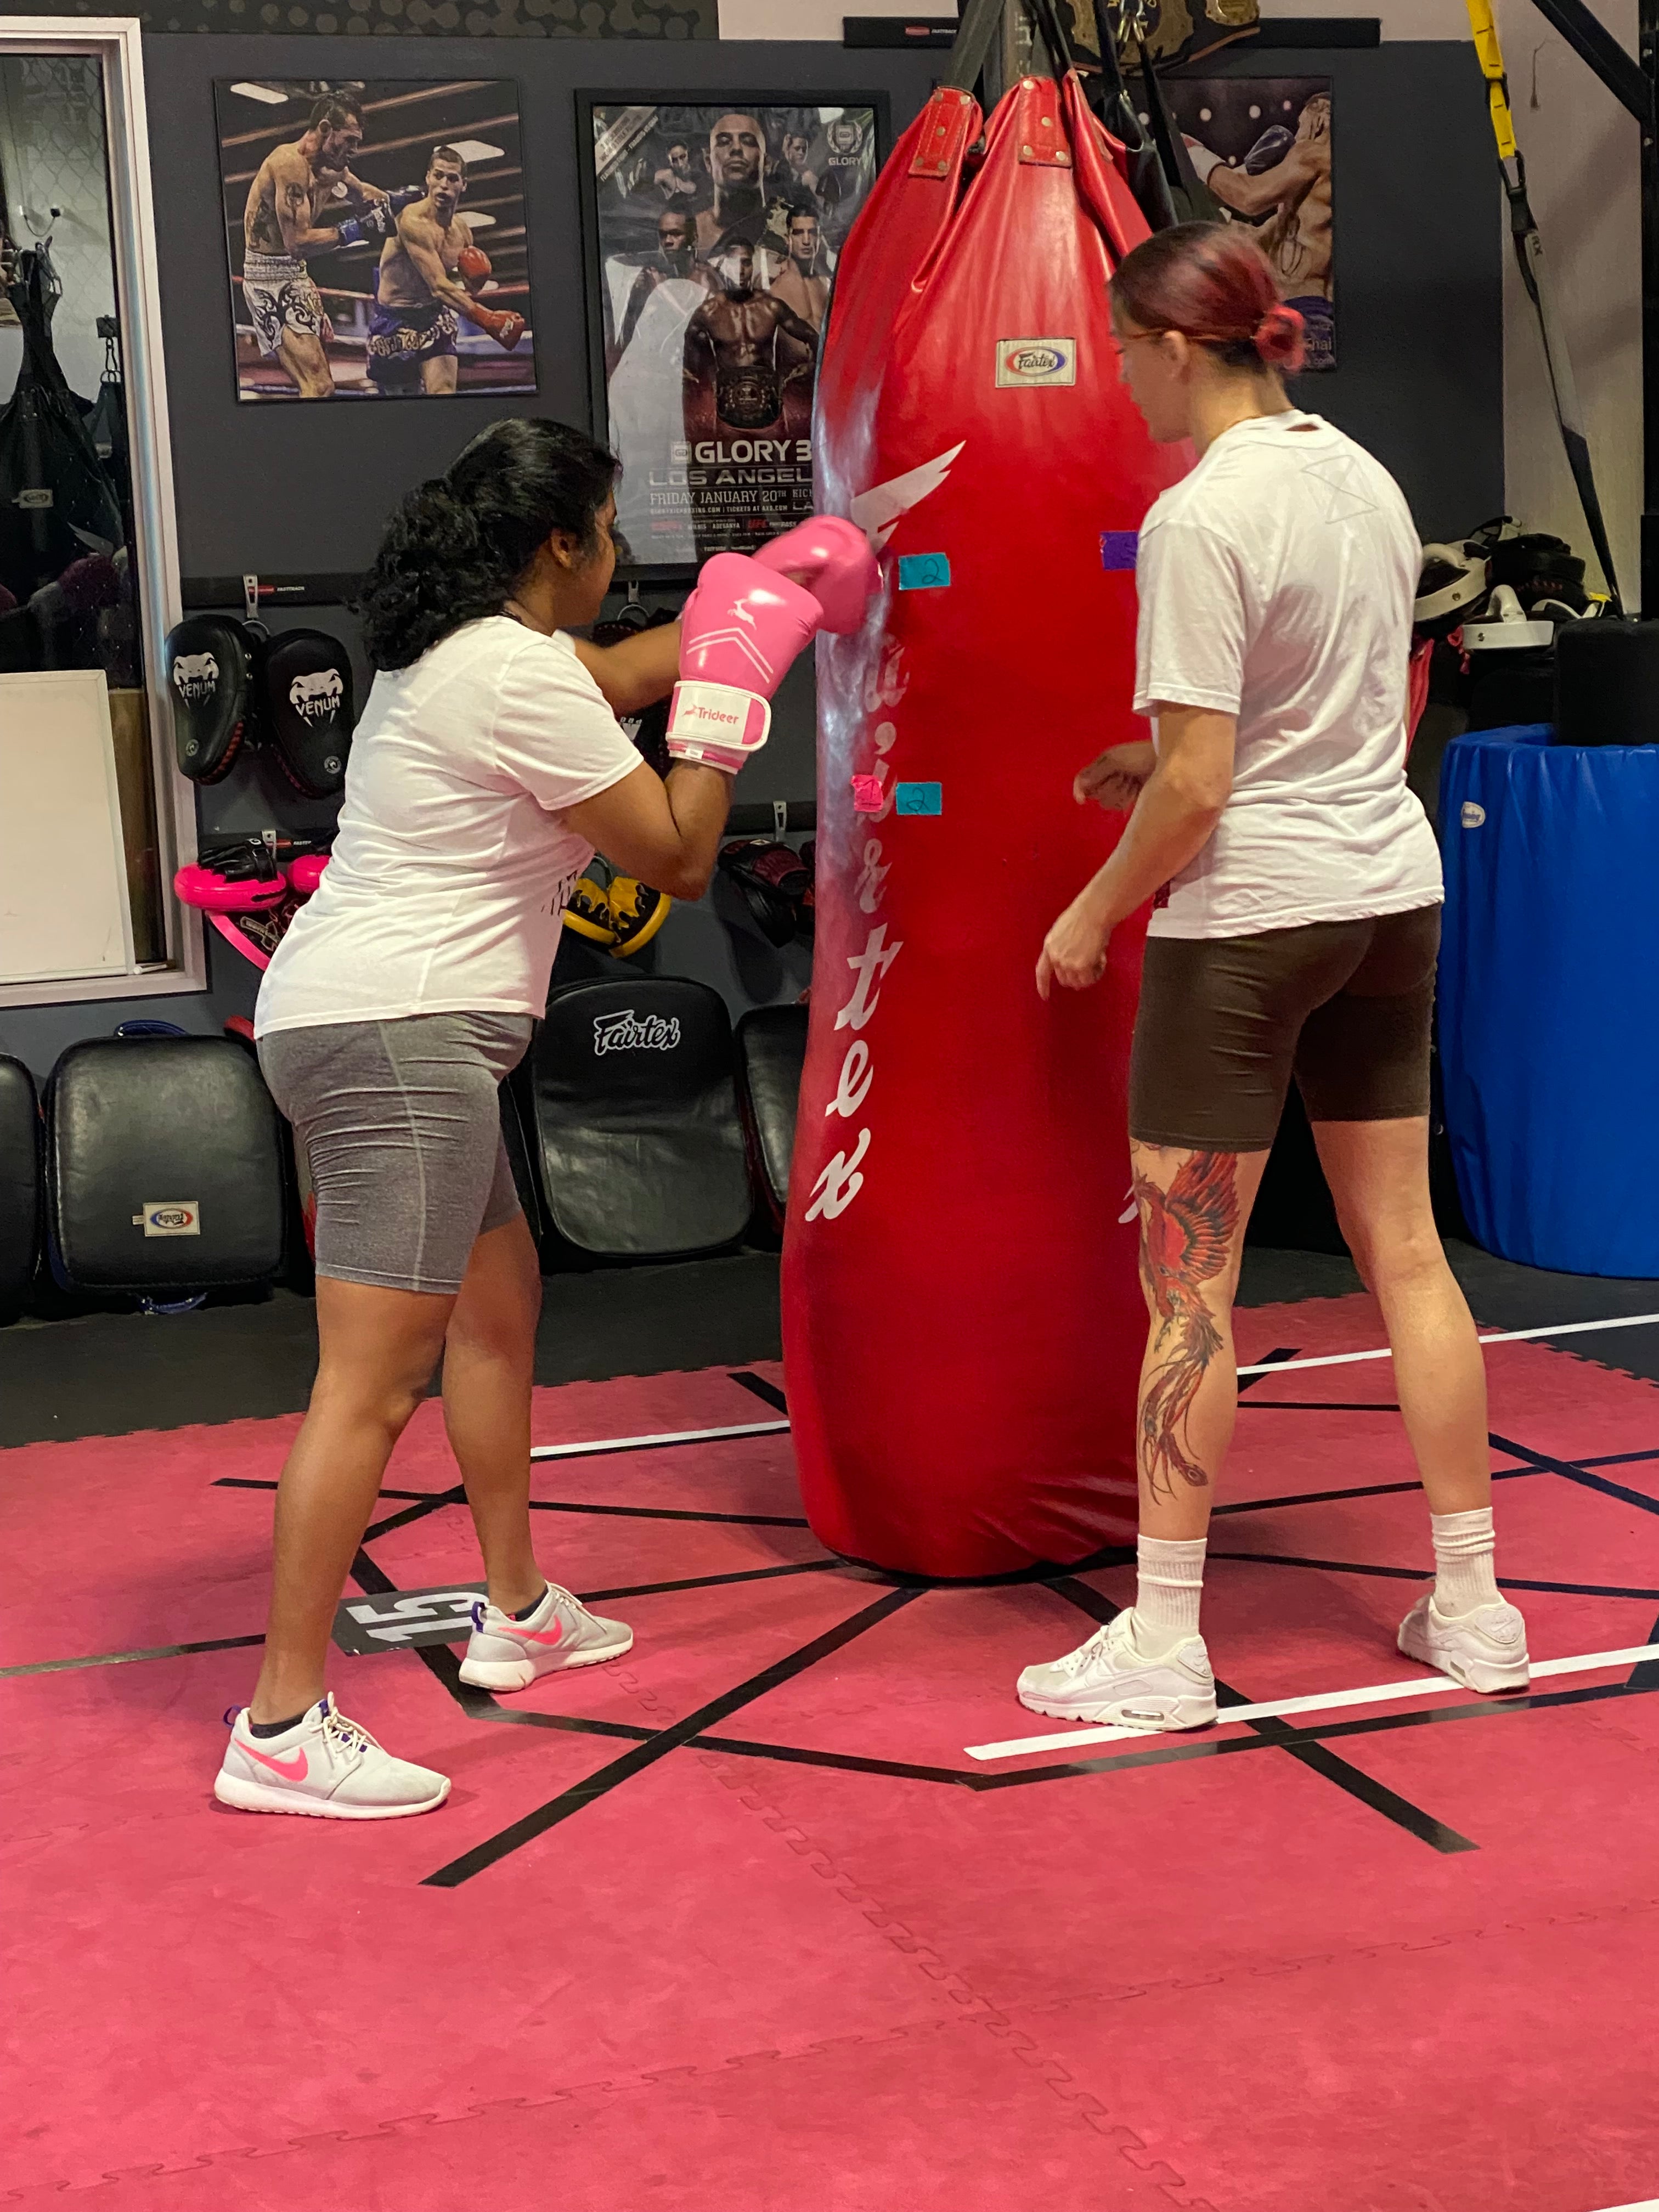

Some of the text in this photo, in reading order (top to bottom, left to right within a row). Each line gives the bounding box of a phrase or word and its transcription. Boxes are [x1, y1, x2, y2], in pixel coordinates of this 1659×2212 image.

[828, 157, 861, 166] GLORY
[1531, 235, 1543, 256] RX
[1018, 352, 1054, 369] Fairtex
[695, 440, 792, 463] GLORY
[649, 470, 707, 486] LOS
[650, 490, 787, 505] FRIDAY JANUARY 20TH
[922, 557, 944, 585] 2
[178, 680, 216, 700] VENUM
[295, 695, 341, 718] VENUM
[698, 707, 740, 725] Trideer
[860, 778, 882, 806] 1
[907, 787, 931, 813] 2
[594, 1009, 680, 1056] Fairtex
[346, 1592, 490, 1642] 15
